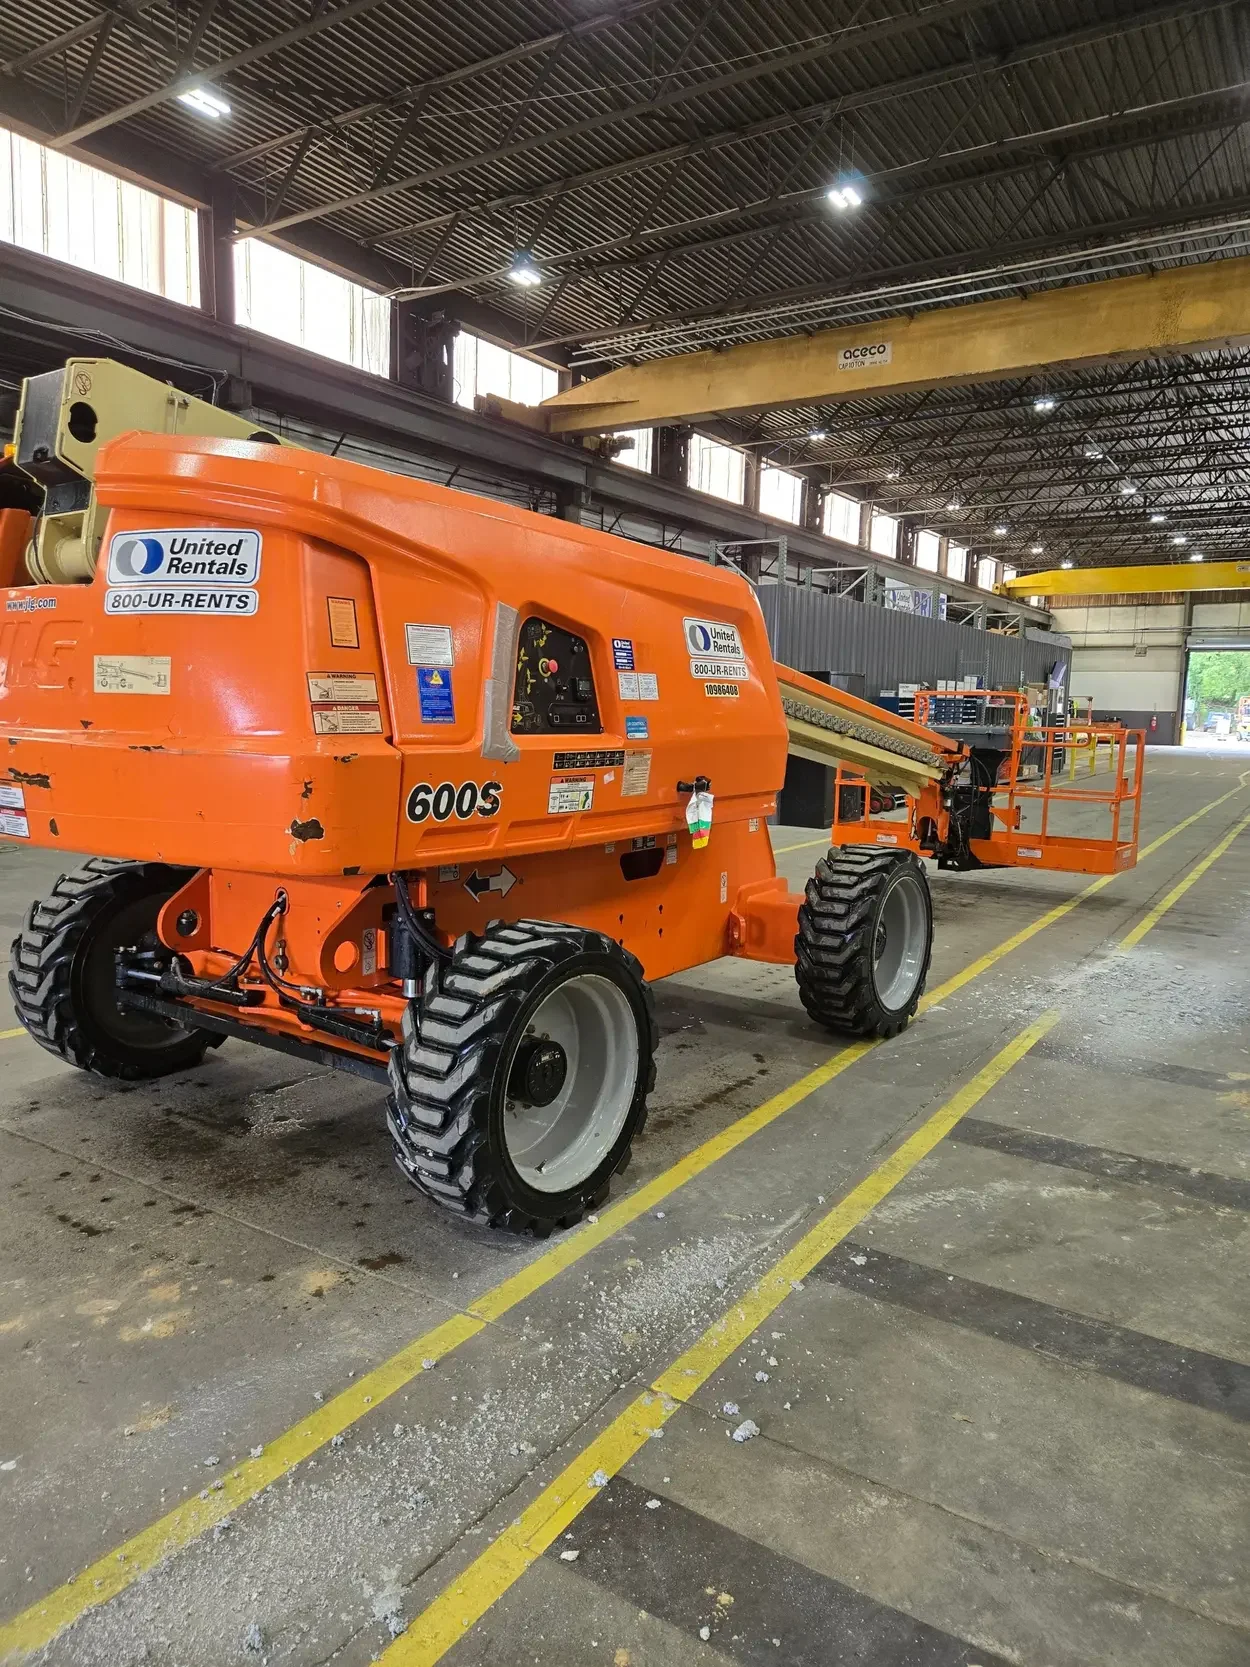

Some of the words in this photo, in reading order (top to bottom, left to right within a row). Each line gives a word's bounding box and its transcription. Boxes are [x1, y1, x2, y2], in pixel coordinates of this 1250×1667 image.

[843, 344, 886, 360] aceco
[838, 362, 849, 370] CAP
[855, 360, 866, 368] TON
[169, 537, 244, 556] United
[166, 557, 249, 576] Rentals
[7, 596, 57, 613] www.jlg.com
[111, 592, 250, 609] 800-UR-RENTS
[710, 627, 736, 642] United
[713, 641, 741, 655] Rentals
[694, 664, 747, 677] 800-UR-RENTS
[705, 684, 739, 696] 10986408
[406, 781, 503, 823] 600S
